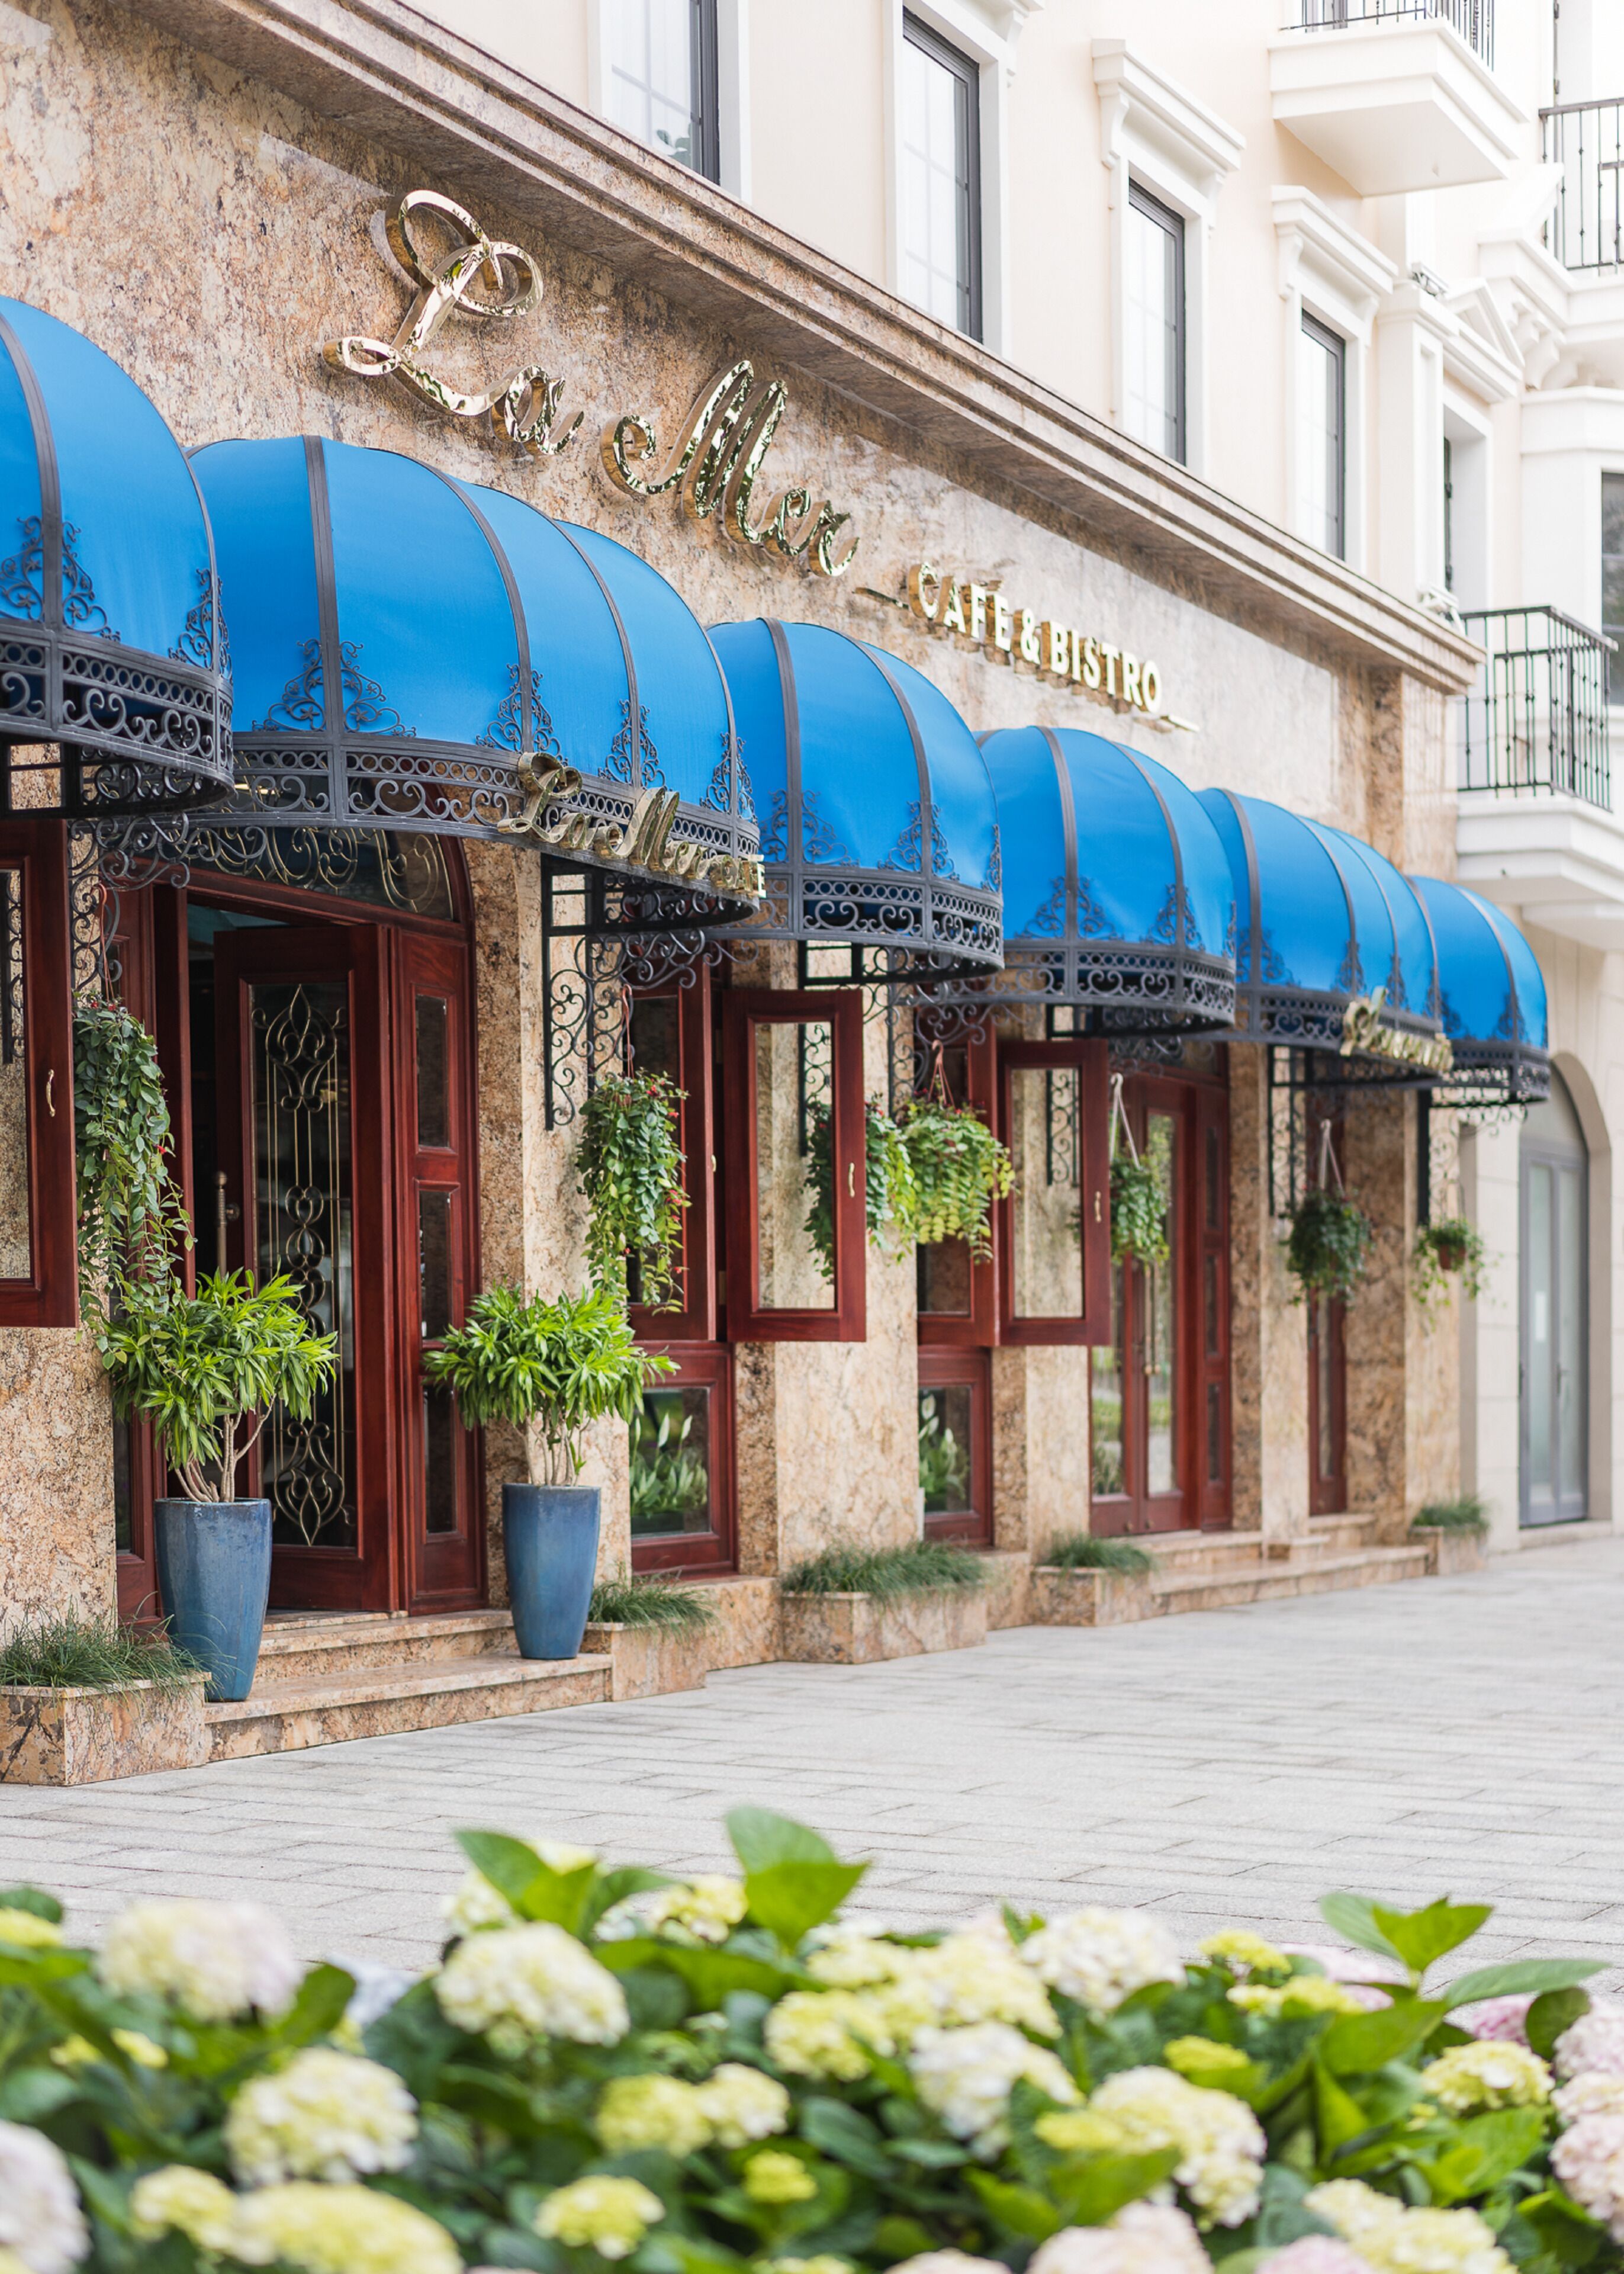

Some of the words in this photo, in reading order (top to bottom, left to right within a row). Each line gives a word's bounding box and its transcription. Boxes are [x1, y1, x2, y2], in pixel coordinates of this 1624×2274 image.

[324, 190, 585, 455] La
[600, 359, 860, 577] Mer
[1014, 608, 1041, 665] &
[1042, 620, 1174, 712] BISTRO
[498, 751, 595, 849] La
[593, 787, 712, 880] Mer
